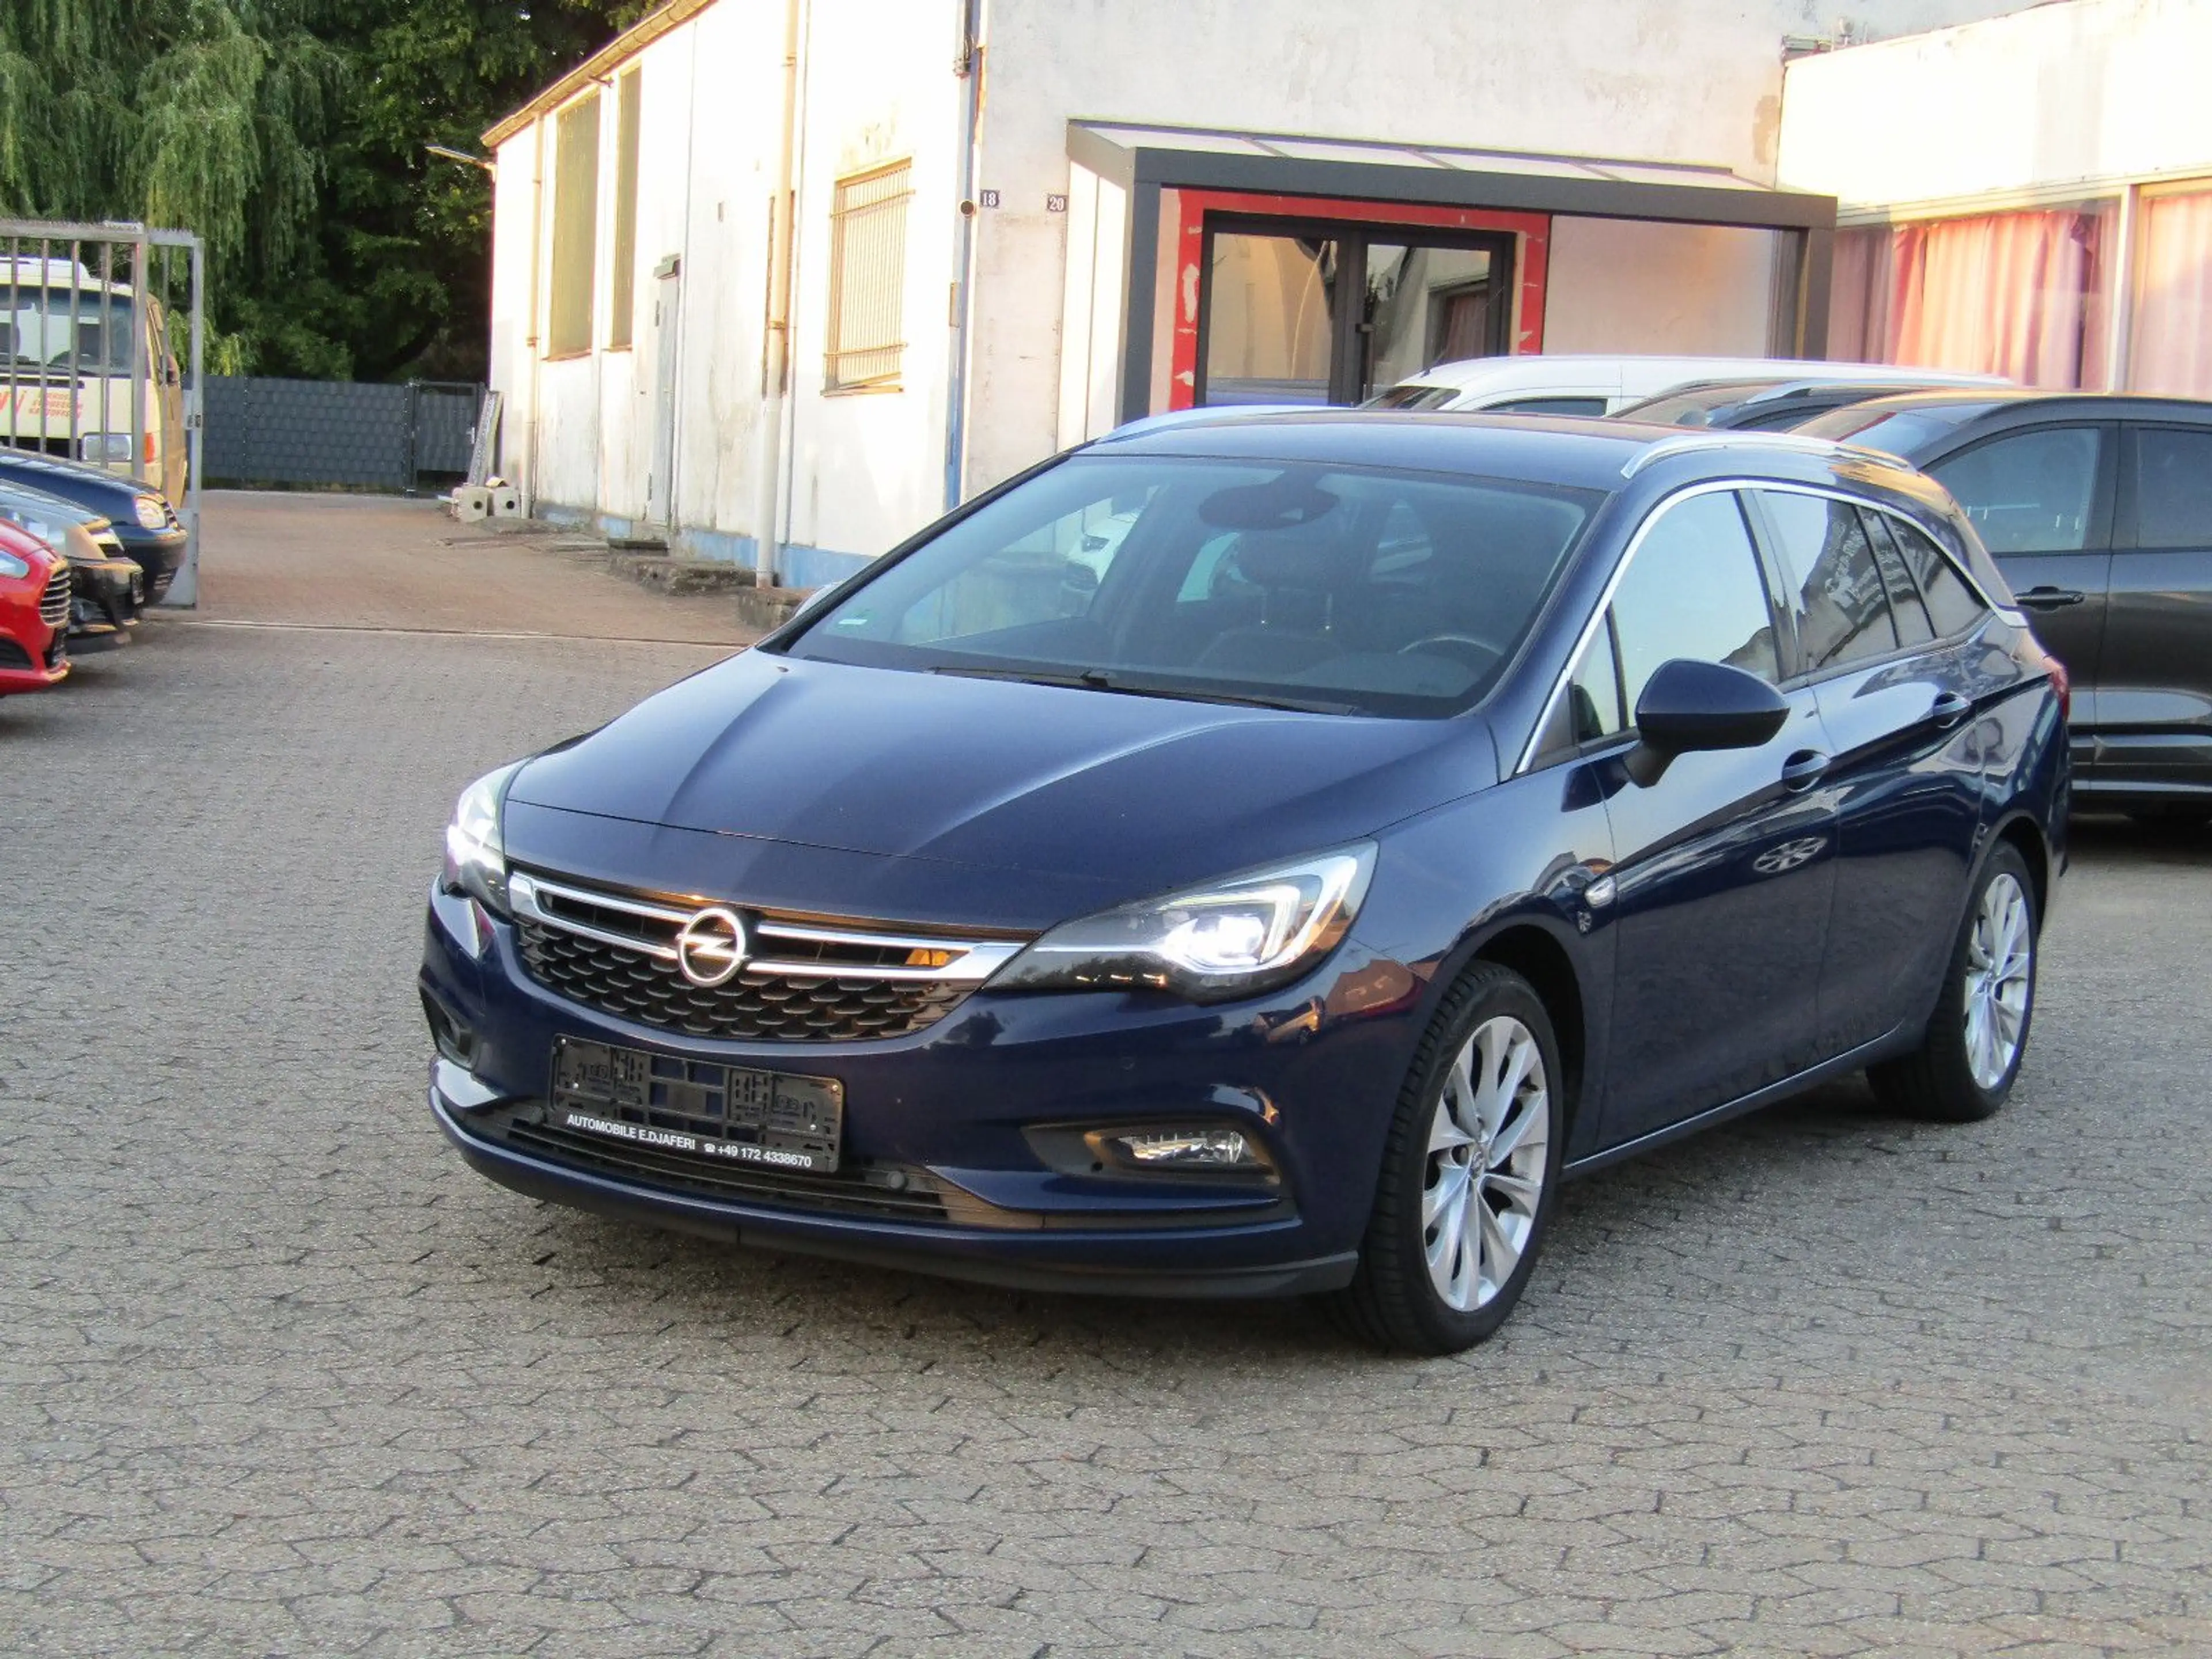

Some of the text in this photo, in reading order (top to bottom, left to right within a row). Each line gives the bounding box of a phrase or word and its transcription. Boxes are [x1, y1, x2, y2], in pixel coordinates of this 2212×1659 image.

[982, 191, 997, 206] 18
[1048, 196, 1065, 211] 20
[567, 1113, 812, 1168] AUTOMOBILE E.DJAFERI +49 172 4338670
